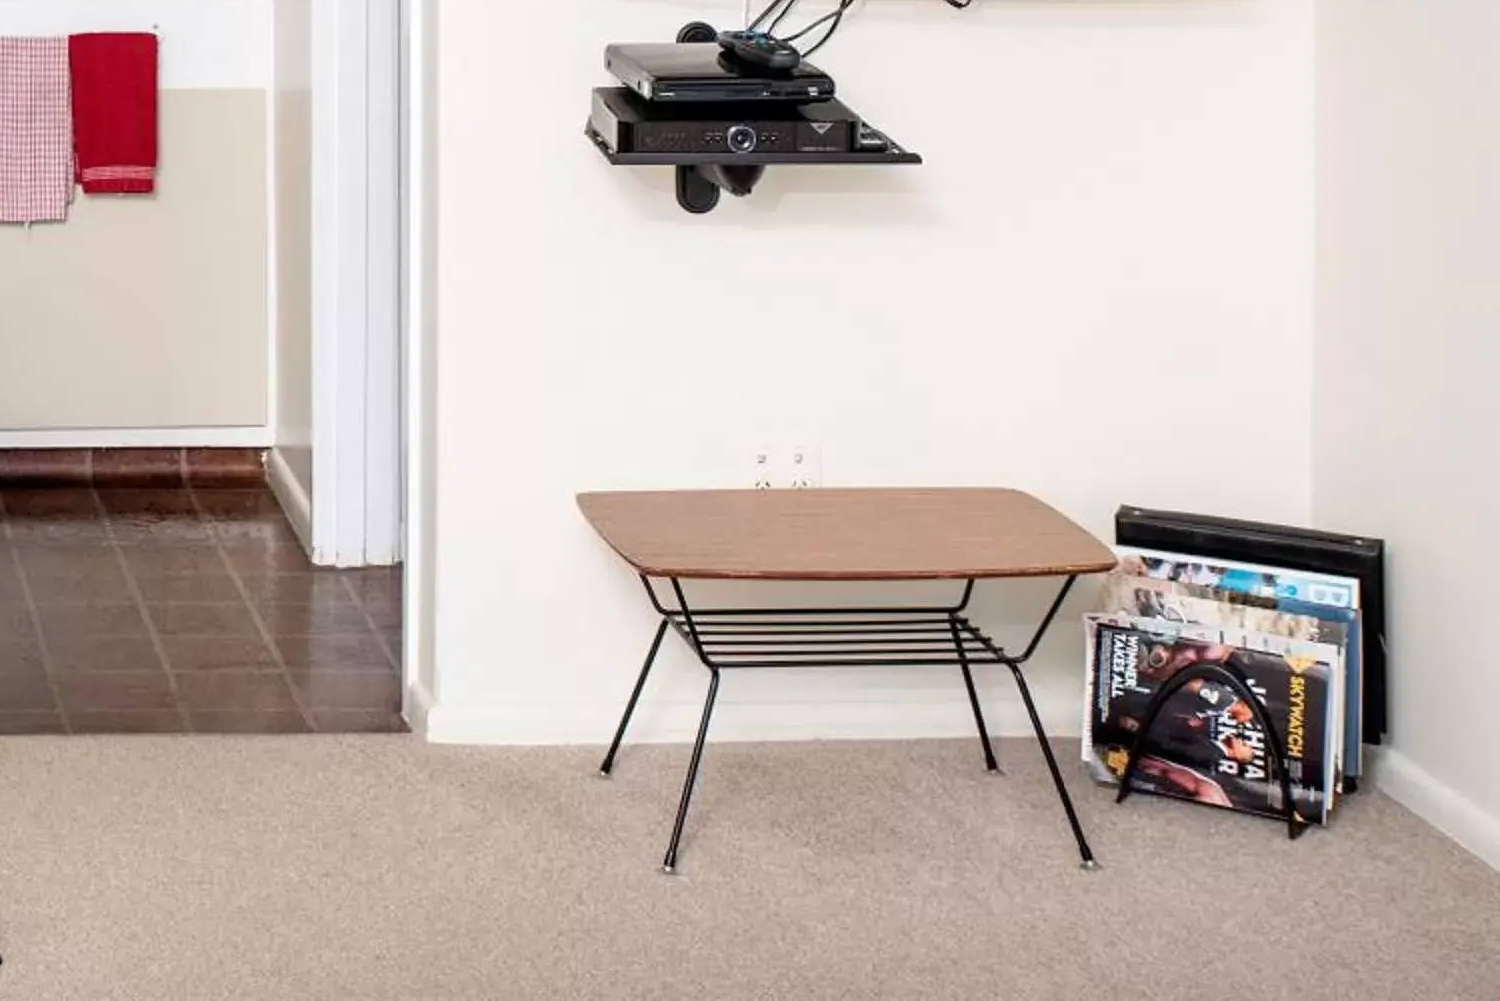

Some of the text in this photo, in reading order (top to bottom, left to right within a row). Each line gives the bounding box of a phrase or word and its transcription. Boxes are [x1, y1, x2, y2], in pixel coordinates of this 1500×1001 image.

[1112, 632, 1126, 699] TAKES ALL
[1124, 634, 1139, 688] WINNER
[1287, 676, 1304, 758] SKYWATCH
